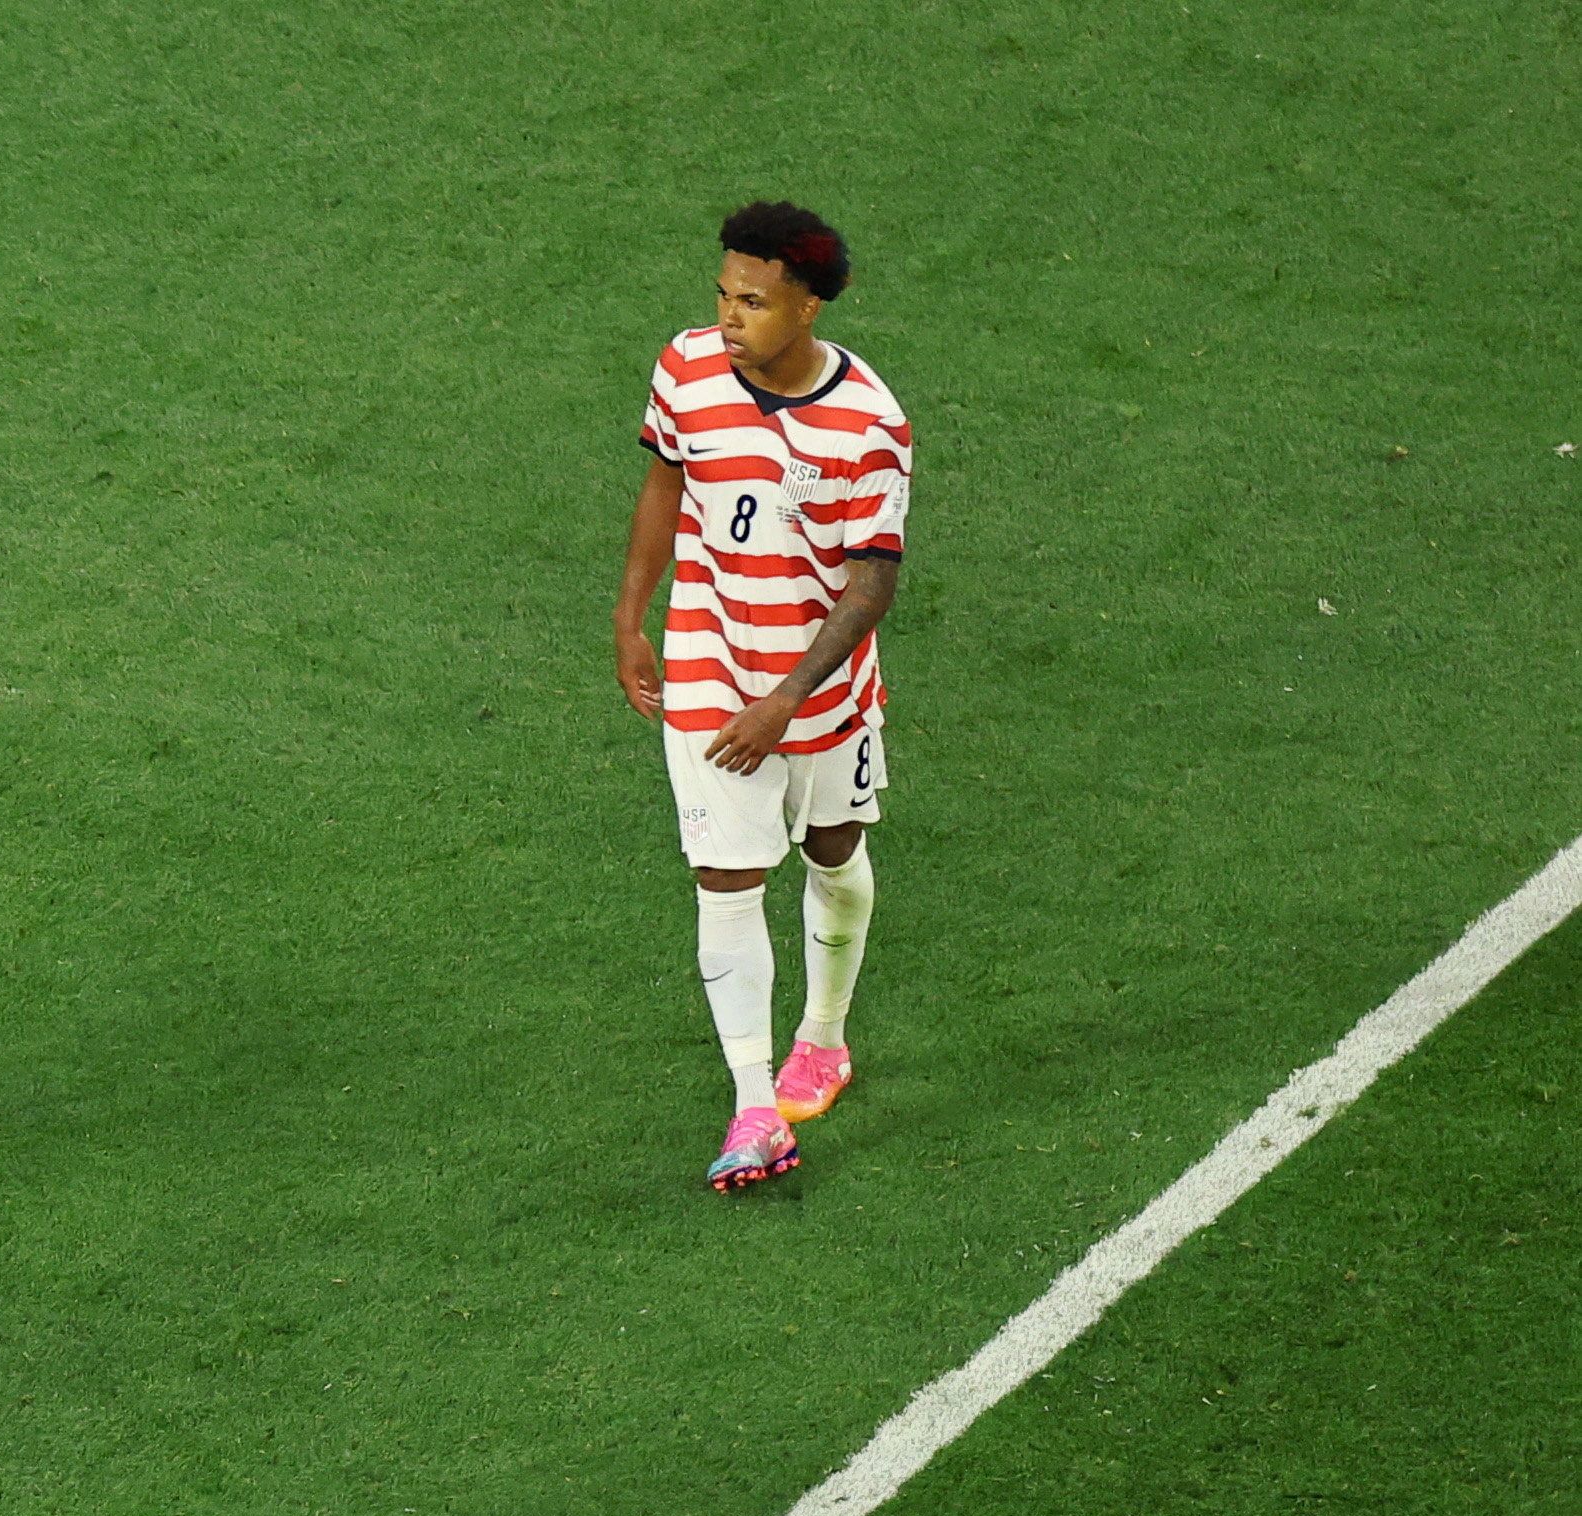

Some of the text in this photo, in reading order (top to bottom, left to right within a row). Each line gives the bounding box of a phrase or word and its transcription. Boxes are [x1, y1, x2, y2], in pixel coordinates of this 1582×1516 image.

[788, 461, 818, 482] USA
[730, 494, 757, 543] 8
[854, 734, 870, 790] 8
[683, 808, 706, 822] USA
